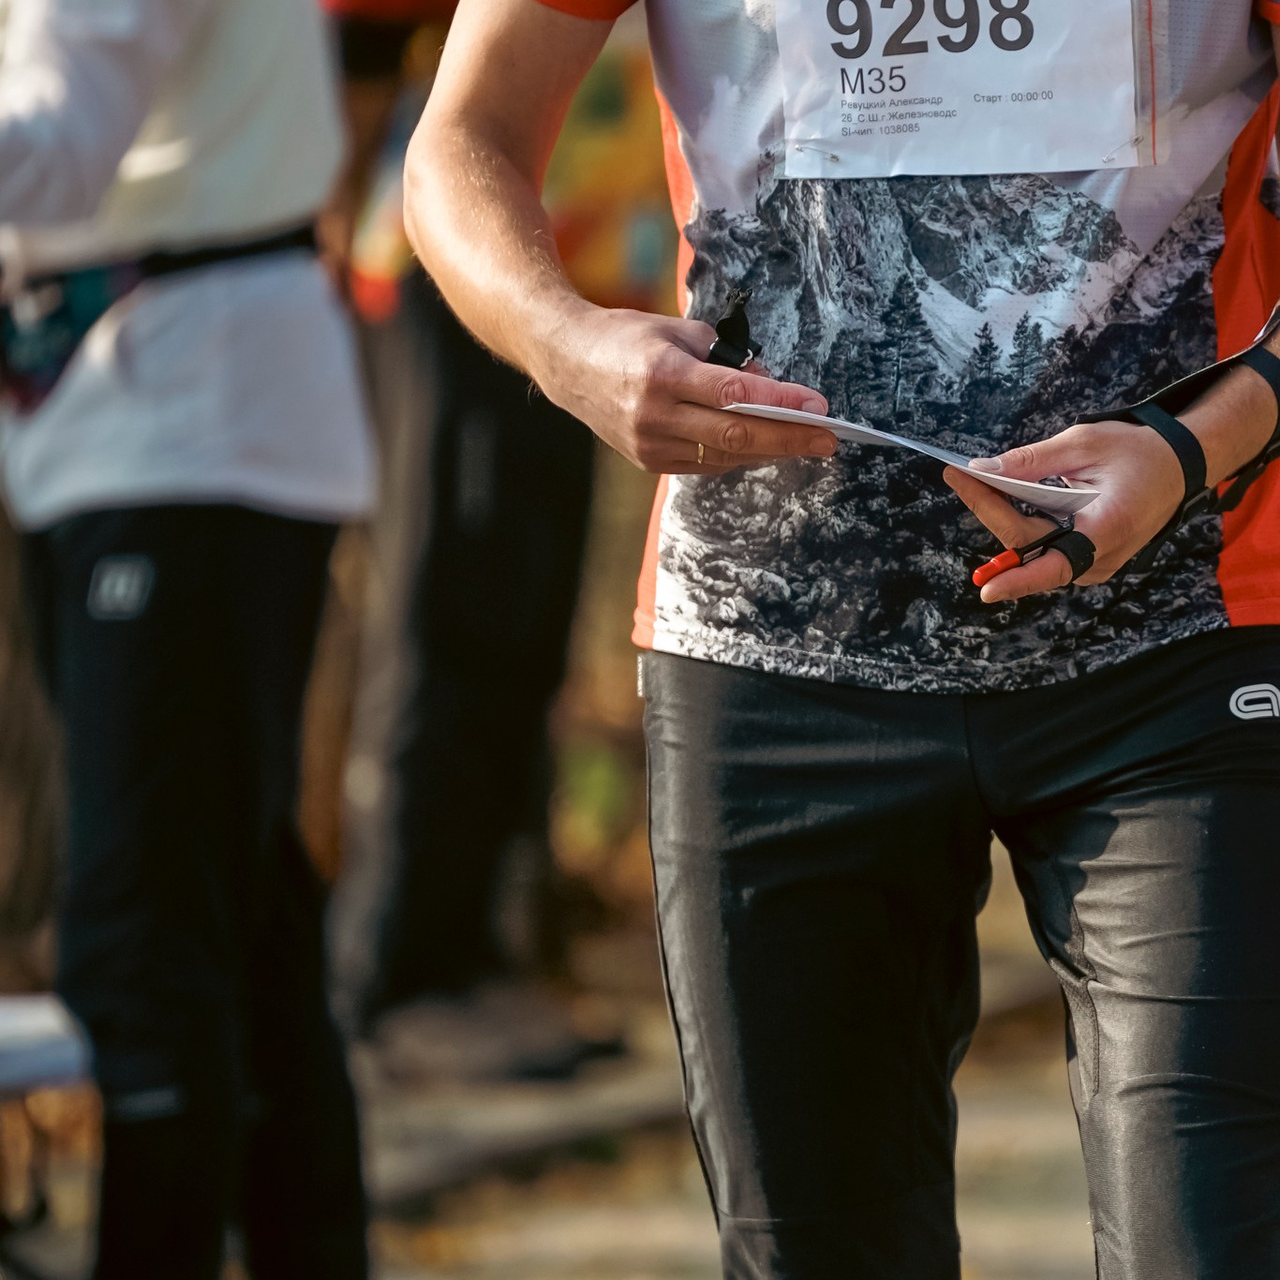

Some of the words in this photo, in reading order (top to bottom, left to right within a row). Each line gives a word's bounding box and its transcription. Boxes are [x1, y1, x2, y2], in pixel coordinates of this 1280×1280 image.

[841, 98, 886, 110] Ревуцкий
[888, 95, 943, 108] Александр
[973, 93, 1002, 103] Старт
[1011, 90, 1053, 102] 00:00:00
[879, 123, 920, 135] 1038085
